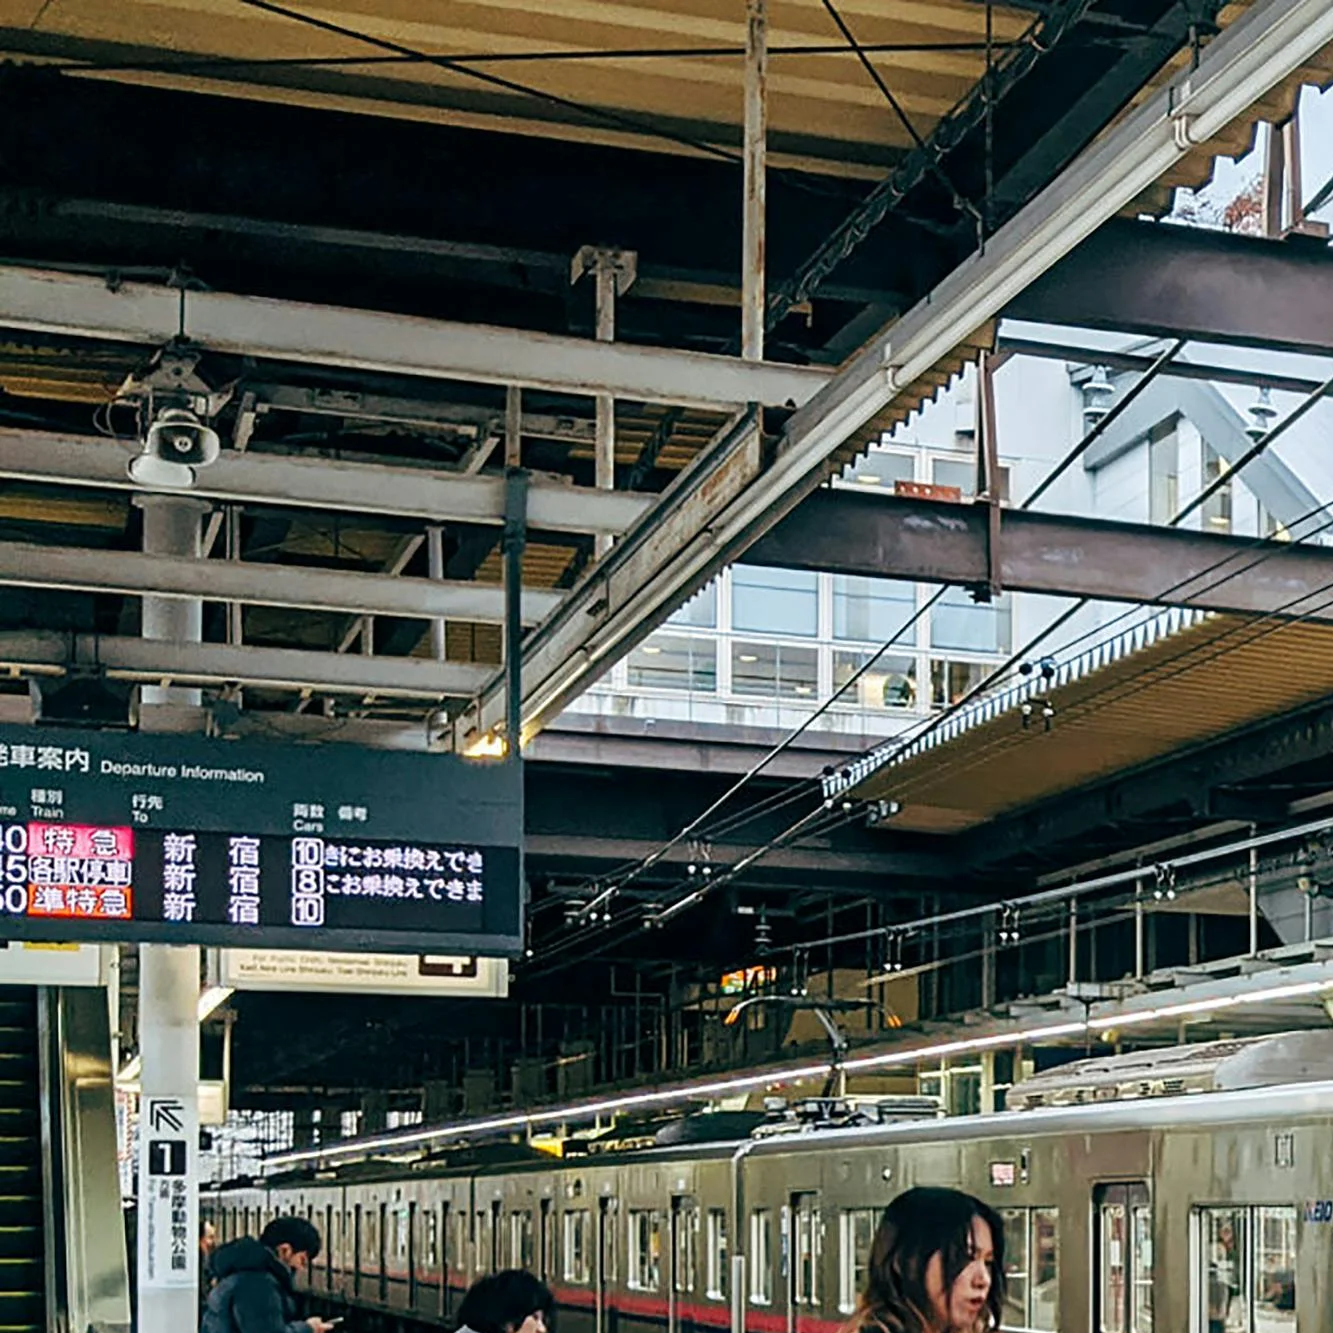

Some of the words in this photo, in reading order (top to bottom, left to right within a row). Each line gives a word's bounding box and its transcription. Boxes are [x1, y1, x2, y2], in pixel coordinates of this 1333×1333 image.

[100, 760, 176, 777] Departure
[181, 765, 264, 783] Information
[31, 789, 63, 805] 種別
[132, 794, 163, 810] 行先
[31, 805, 64, 819] Train
[132, 811, 148, 823] To
[293, 819, 323, 832] Cars
[0, 825, 27, 853] 0
[45, 828, 119, 855] 特急
[163, 832, 261, 866] 新宿
[296, 841, 318, 865] 10
[0, 855, 27, 883] 5
[32, 858, 128, 885] 各駅停車
[163, 864, 261, 894] 新宿
[298, 870, 317, 890] 8
[0, 884, 27, 913] 0
[34, 886, 127, 915] 準特急
[163, 892, 261, 923] 新宿
[296, 900, 318, 921] 10
[156, 1143, 172, 1174] 1
[172, 1180, 187, 1270] 多摩動物公園
